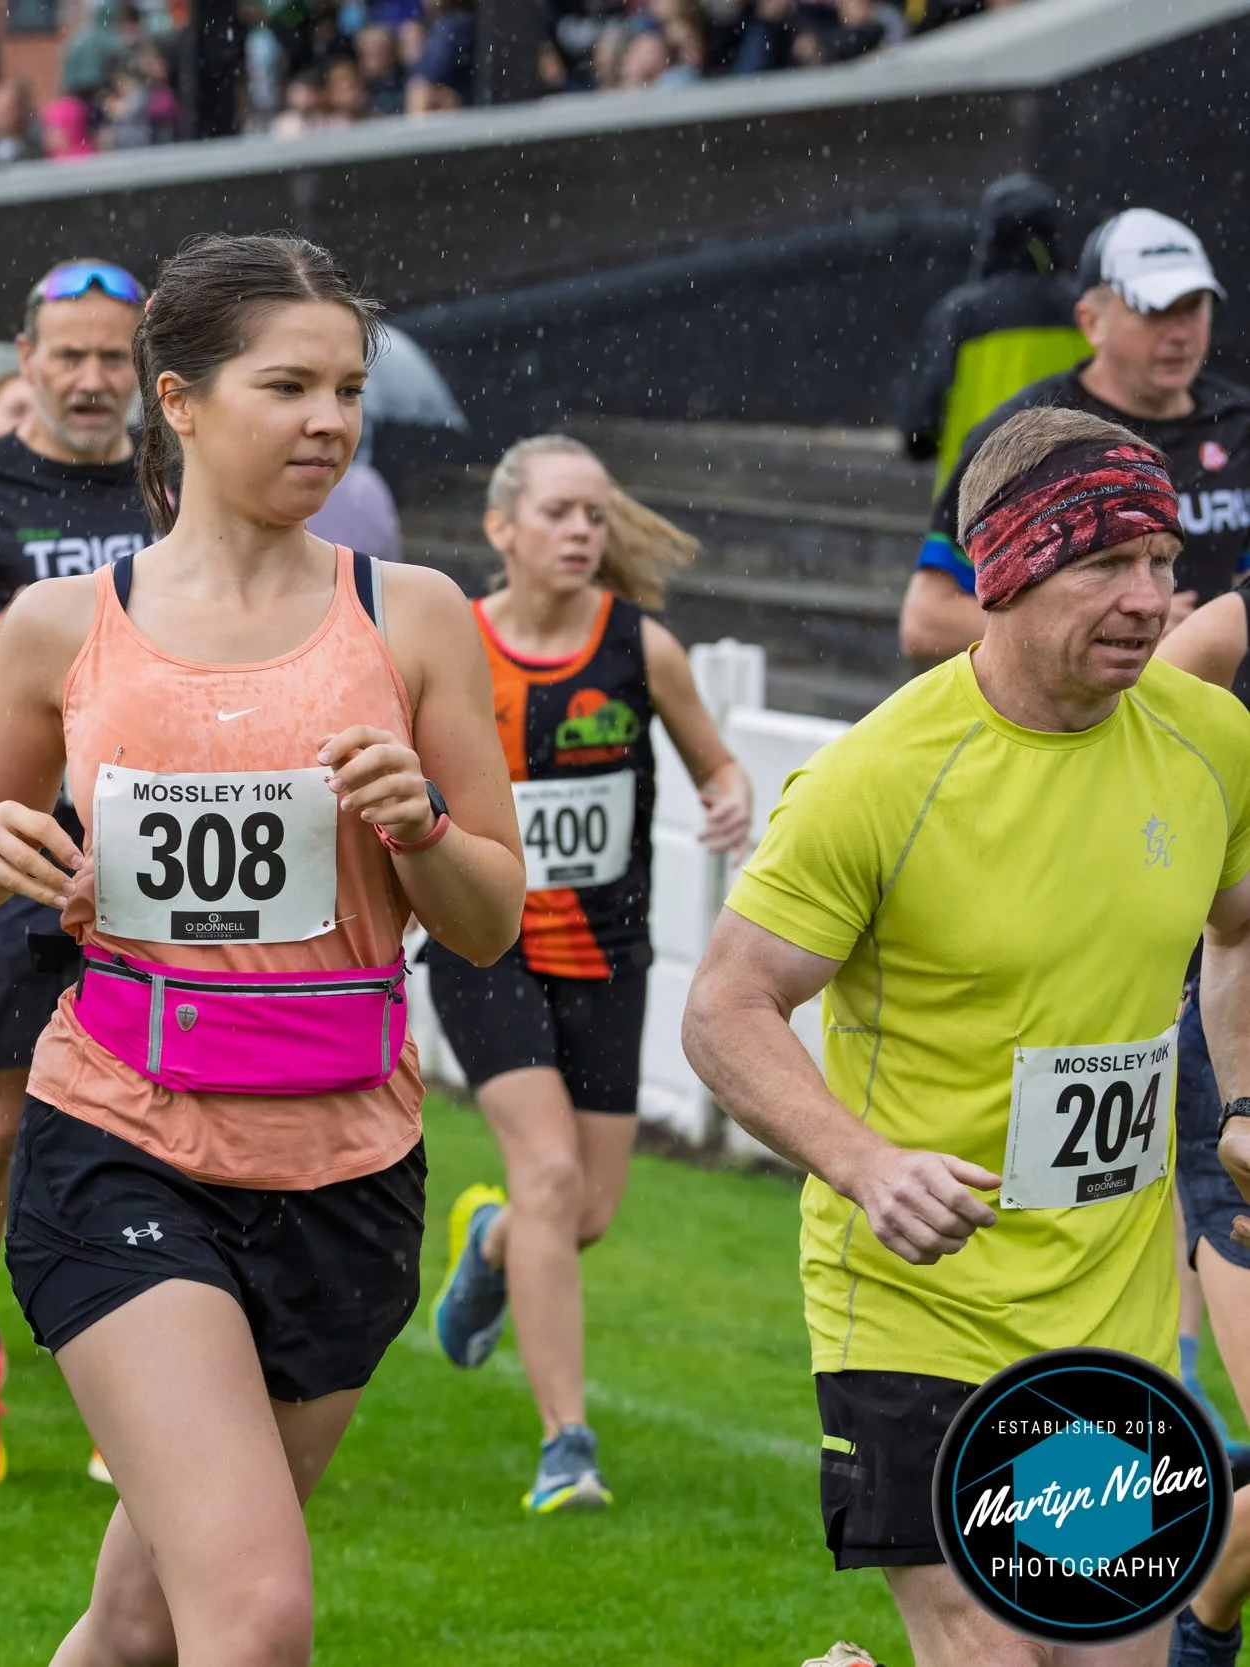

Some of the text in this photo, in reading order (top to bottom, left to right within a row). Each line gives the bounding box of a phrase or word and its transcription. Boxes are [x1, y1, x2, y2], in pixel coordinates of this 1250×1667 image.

[133, 782, 293, 803] MOSSLEY 10K
[525, 804, 608, 859] 400
[136, 811, 287, 902] 308
[185, 922, 245, 932] O'DONNELL
[1054, 1043, 1169, 1074] MOSSLEY 10K
[1050, 1071, 1161, 1168] 204
